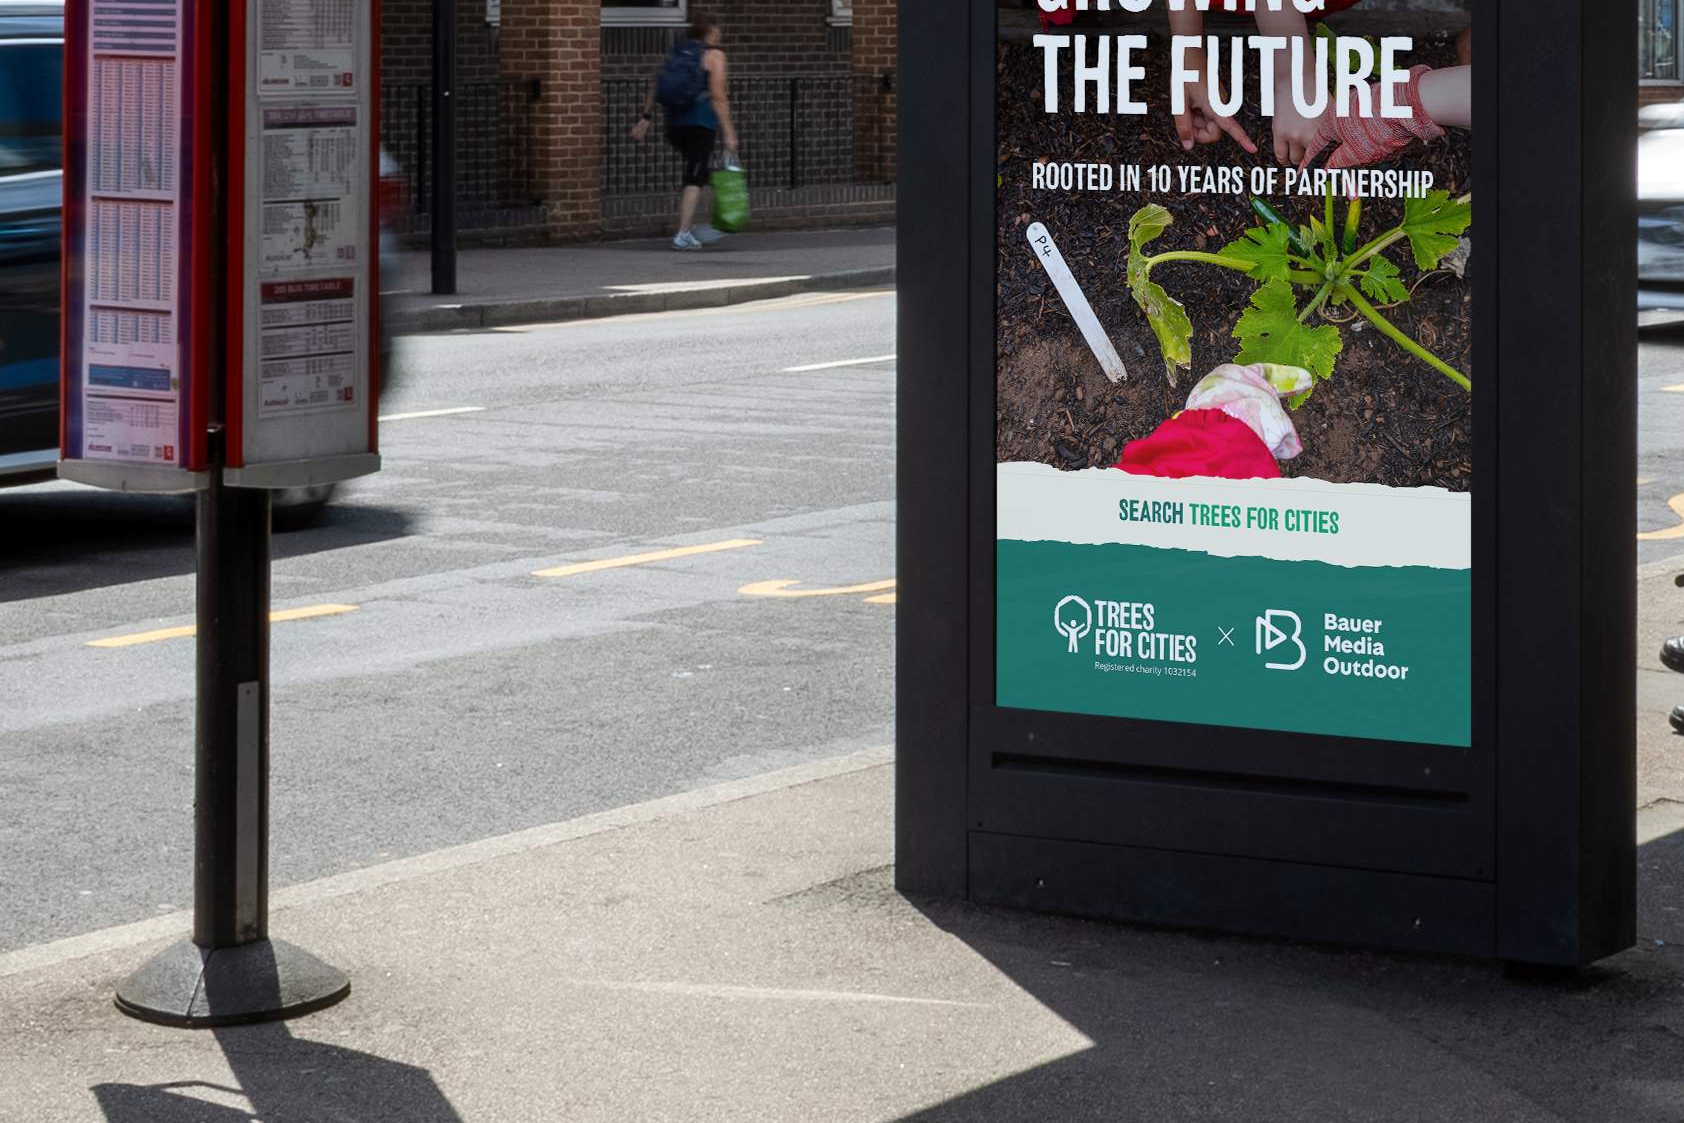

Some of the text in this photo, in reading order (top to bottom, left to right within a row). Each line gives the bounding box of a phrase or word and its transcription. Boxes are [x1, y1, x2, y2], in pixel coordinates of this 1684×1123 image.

[1033, 34, 1413, 119] THE FUTURE
[1032, 162, 1435, 199] ROOTED IN 10 YEARS OF PARTNERSHIP
[1119, 499, 1339, 534] SEARCH TREES FOR CITIES
[1094, 600, 1155, 631] TREES
[1324, 613, 1382, 635] Bauer
[1095, 630, 1197, 663] FOR CITIES
[1324, 635, 1385, 657] Media
[1094, 661, 1134, 675] Registered
[1136, 663, 1162, 677] charity
[1324, 657, 1409, 681] Outdoor
